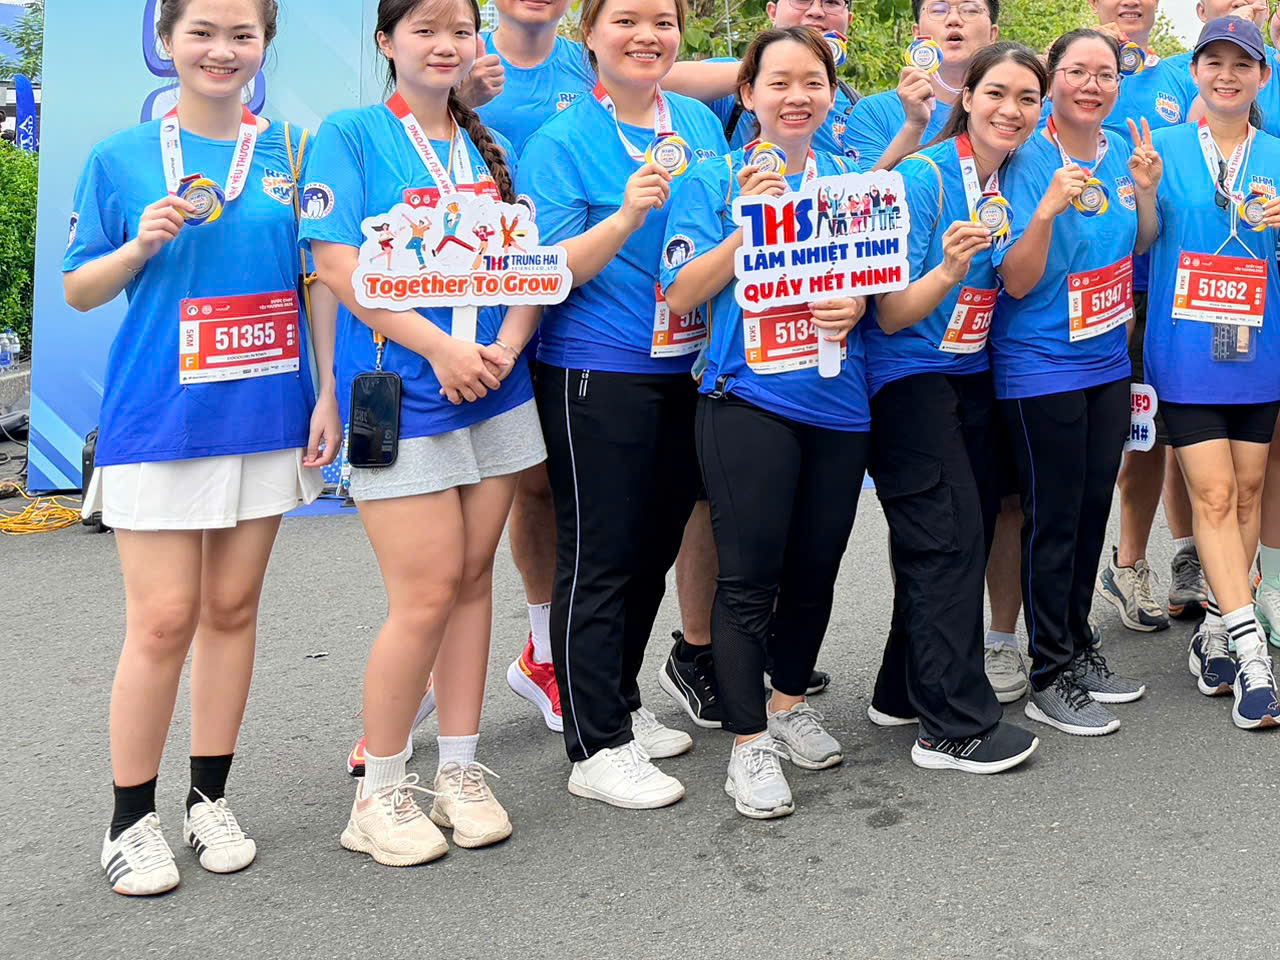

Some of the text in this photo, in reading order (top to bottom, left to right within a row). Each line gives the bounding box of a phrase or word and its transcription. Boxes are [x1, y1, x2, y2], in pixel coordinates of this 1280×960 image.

[1252, 175, 1273, 186] RHM
[741, 198, 813, 247] THS
[483, 254, 558, 271] THS TRUNG HAI
[743, 237, 900, 272] LÀM NHIỆT TÌNH
[366, 274, 560, 297] Together To Grow
[809, 268, 845, 294] HẾT
[851, 265, 902, 289] MÌNH
[1198, 277, 1248, 301] 51362
[1091, 283, 1122, 312] 51347
[186, 329, 194, 347] 5KM
[215, 322, 276, 351] 51355
[656, 333, 665, 344] F
[775, 319, 819, 344] 5134
[185, 356, 194, 368] F
